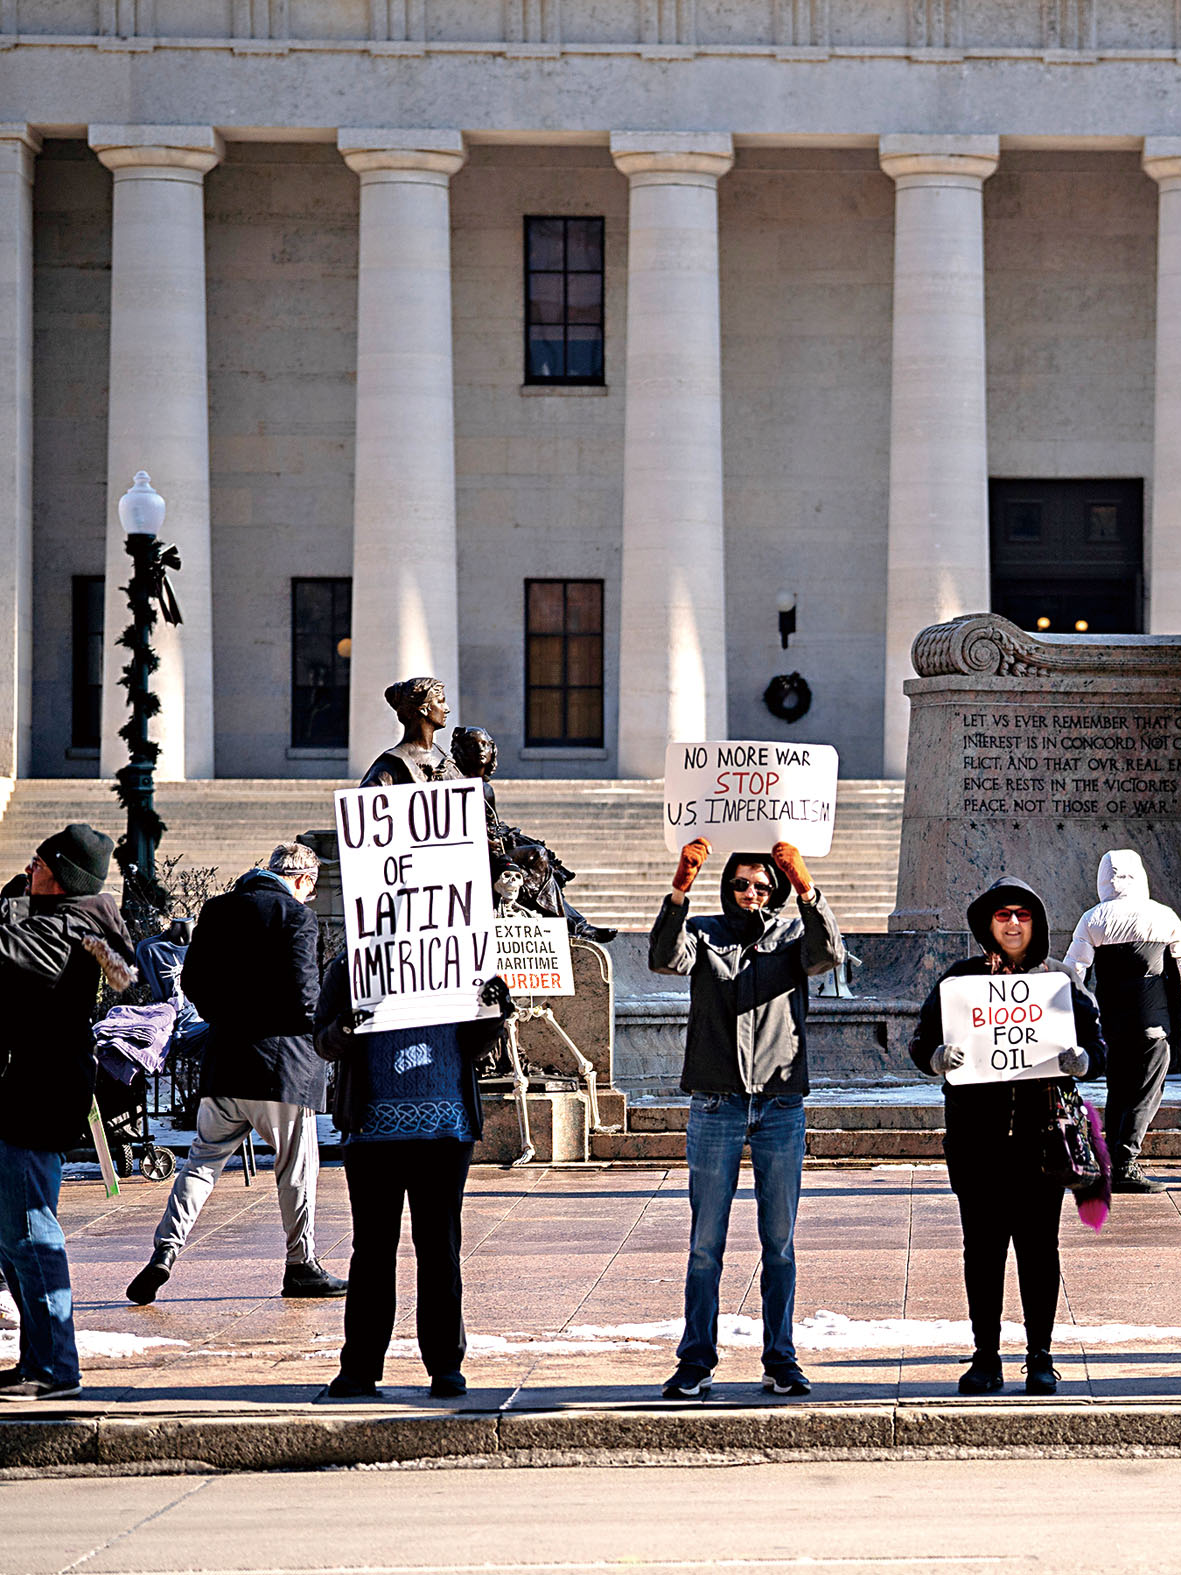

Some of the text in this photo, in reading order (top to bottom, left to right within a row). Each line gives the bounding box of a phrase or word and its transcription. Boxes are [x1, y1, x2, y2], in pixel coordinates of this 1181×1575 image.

[1014, 714, 1048, 729] EVER
[1052, 715, 1129, 729] REMEMBER
[1133, 715, 1171, 730] THAT
[963, 732, 1021, 750] INTEREST
[1026, 735, 1038, 750] IS
[1042, 735, 1057, 750] IN
[1140, 735, 1170, 751] NOT
[684, 746, 811, 770] NO MORE WAR
[1007, 756, 1039, 771] AND
[1043, 757, 1081, 771] THAT
[1126, 758, 1163, 772] REAL
[713, 771, 780, 796] STOP
[963, 777, 1000, 791] ENCE
[1005, 778, 1045, 792] RESTS
[1051, 778, 1066, 792] IN
[1071, 779, 1099, 792] THE
[1106, 777, 1178, 792] VICTORIES
[408, 786, 476, 842] OUT
[667, 798, 831, 826] U.S. IMPERIALISM
[1014, 799, 1046, 813] NOT
[1051, 800, 1098, 813] THOSE
[1106, 800, 1127, 814] OF
[383, 854, 413, 886] OF
[355, 881, 473, 939] LATIN
[495, 925, 551, 938] EXTRA-
[496, 941, 556, 954] JUDICIAL
[496, 973, 562, 989] URDER
[989, 980, 1030, 1003] NO
[994, 1026, 1038, 1045] FOR
[991, 1048, 1033, 1070] OIL
